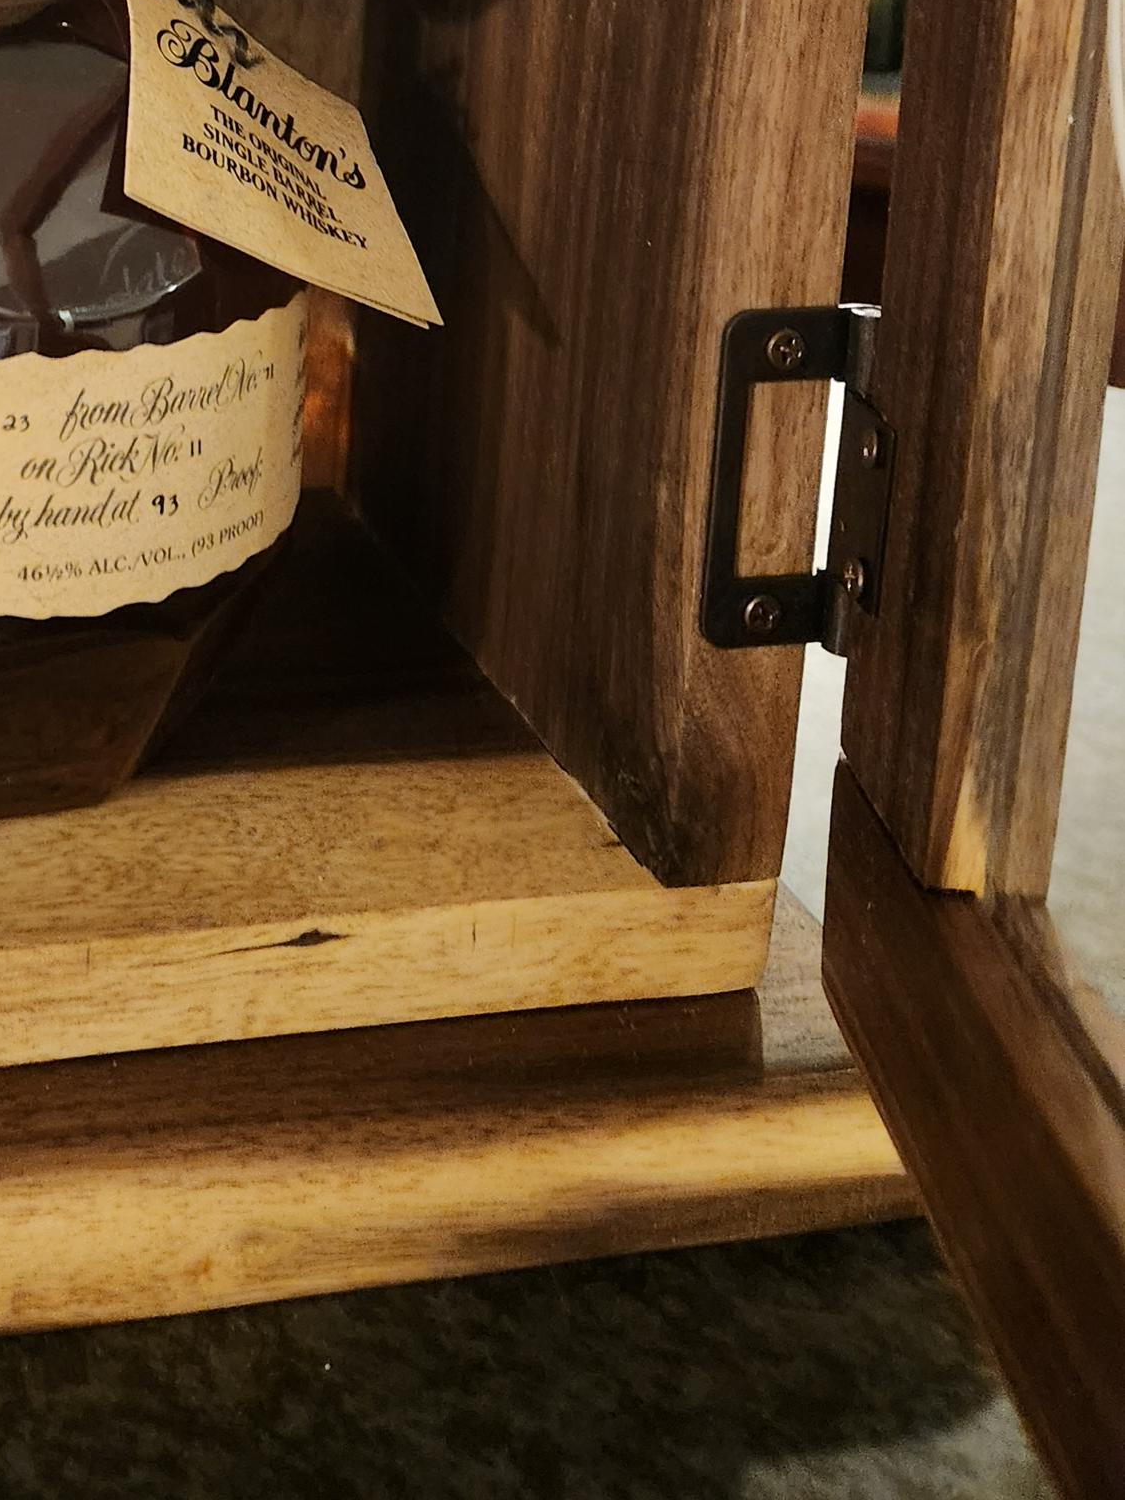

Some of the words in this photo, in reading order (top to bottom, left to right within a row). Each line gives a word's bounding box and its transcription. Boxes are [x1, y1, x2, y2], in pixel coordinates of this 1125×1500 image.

[157, 19, 366, 189] Blanton's
[182, 133, 278, 201] BOURBON
[282, 191, 367, 249] WHISKEY
[203, 122, 269, 176] SINGLE
[272, 165, 343, 223] BARREL
[210, 104, 246, 140] THE
[249, 132, 327, 200] ORIGINAL
[59, 388, 131, 441] from
[131, 364, 230, 426] Barrel
[21, 457, 57, 482] on
[56, 437, 138, 487] Rick
[34, 488, 115, 529] hand
[111, 490, 140, 526] at
[152, 494, 179, 516] 93
[191, 532, 216, 557] (93
